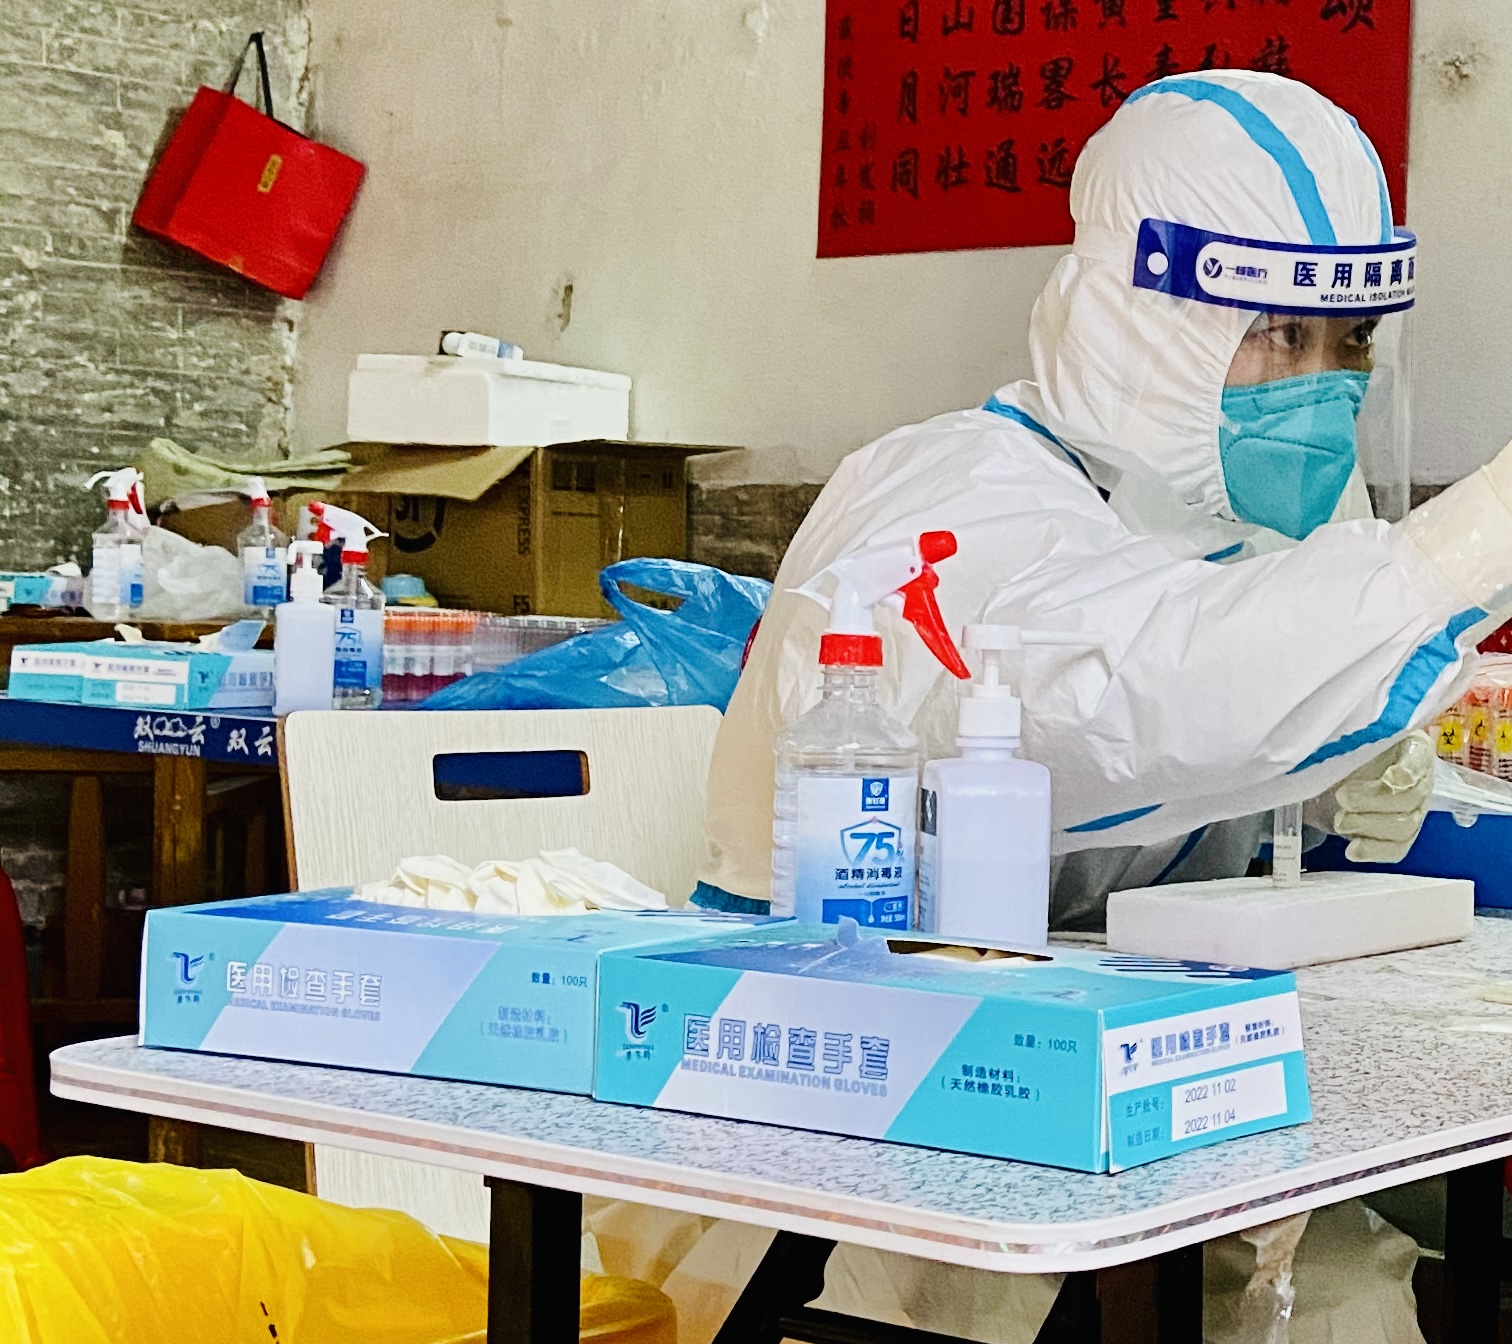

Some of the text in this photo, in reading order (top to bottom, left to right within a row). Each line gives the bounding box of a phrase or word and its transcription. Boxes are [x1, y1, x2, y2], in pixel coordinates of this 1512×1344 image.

[1320, 293, 1366, 302] MEDICAL
[518, 485, 531, 555] EXPRESS
[335, 631, 357, 645] 75
[138, 739, 201, 757] SHUANGYUN
[227, 725, 273, 756] 双云
[849, 831, 895, 866] 75
[226, 960, 383, 1007] 医用检查手套
[684, 1013, 890, 1081] 医用检查手套
[680, 1057, 888, 1098] MEDICAL EXAMINATION GLOVES
[1184, 1078, 1237, 1104] 2022 11 02
[1184, 1108, 1237, 1135] 2022 11 04
